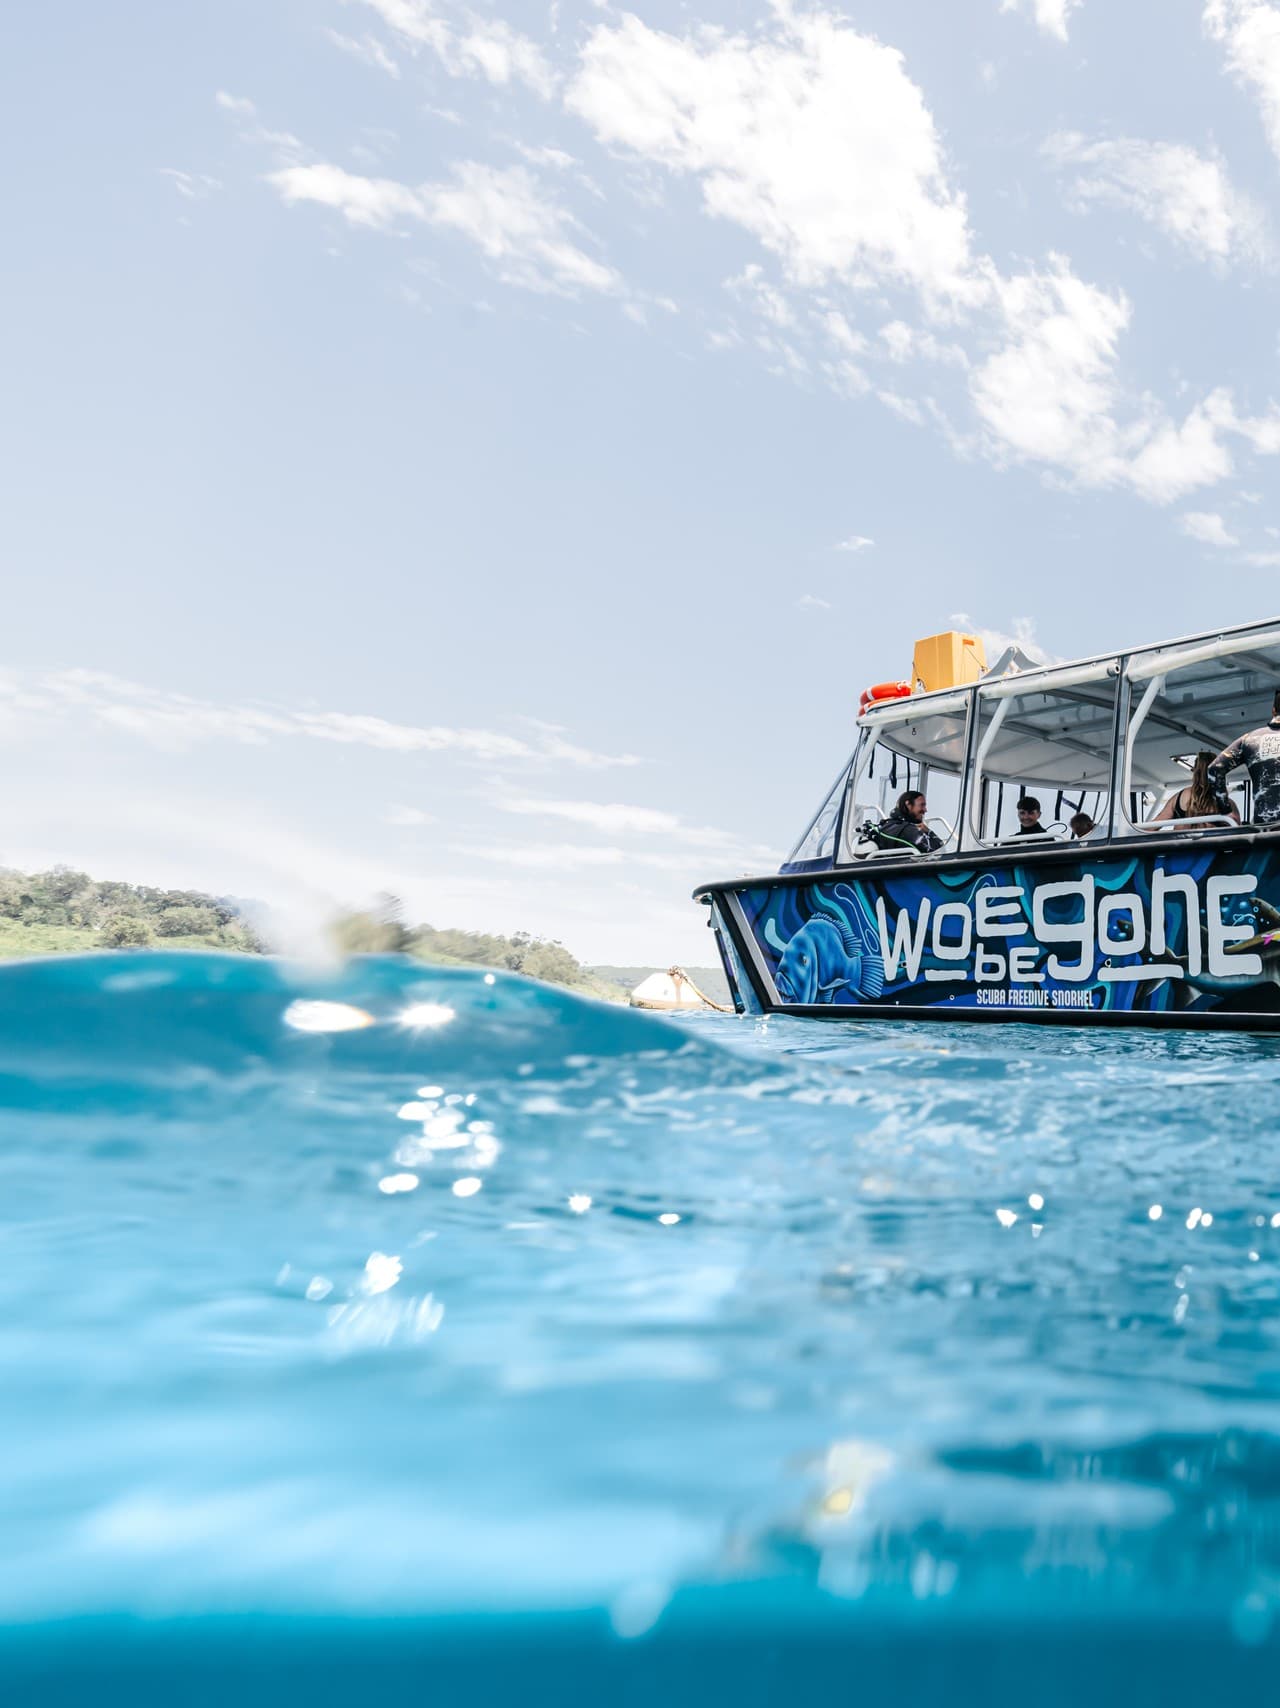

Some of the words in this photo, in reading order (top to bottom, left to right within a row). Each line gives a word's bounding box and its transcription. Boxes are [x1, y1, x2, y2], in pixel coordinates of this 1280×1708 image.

[976, 988, 1006, 1005] SCUBA
[1008, 989, 1050, 1006] FREEDIVE
[1051, 989, 1094, 1007] SNORKEL
